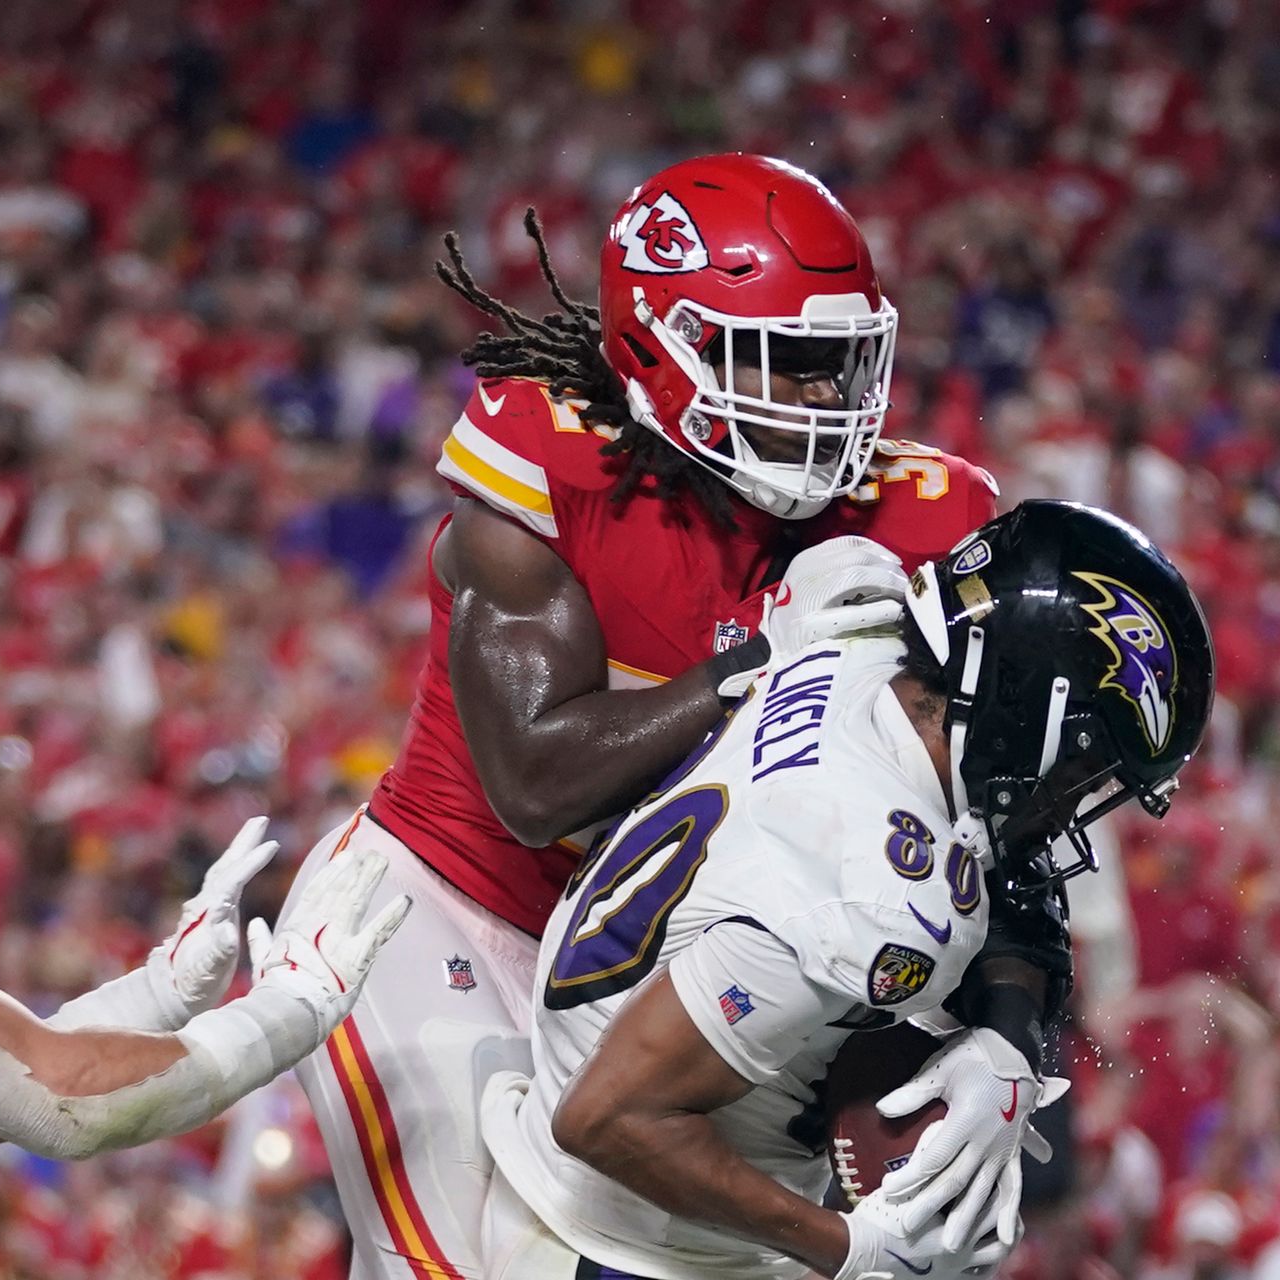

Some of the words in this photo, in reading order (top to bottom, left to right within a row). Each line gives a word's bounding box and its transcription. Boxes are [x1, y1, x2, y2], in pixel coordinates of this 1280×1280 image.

[636, 207, 696, 268] KC
[752, 650, 841, 783] LIKELY
[884, 808, 982, 916] 80
[886, 946, 932, 969] RAVENS
